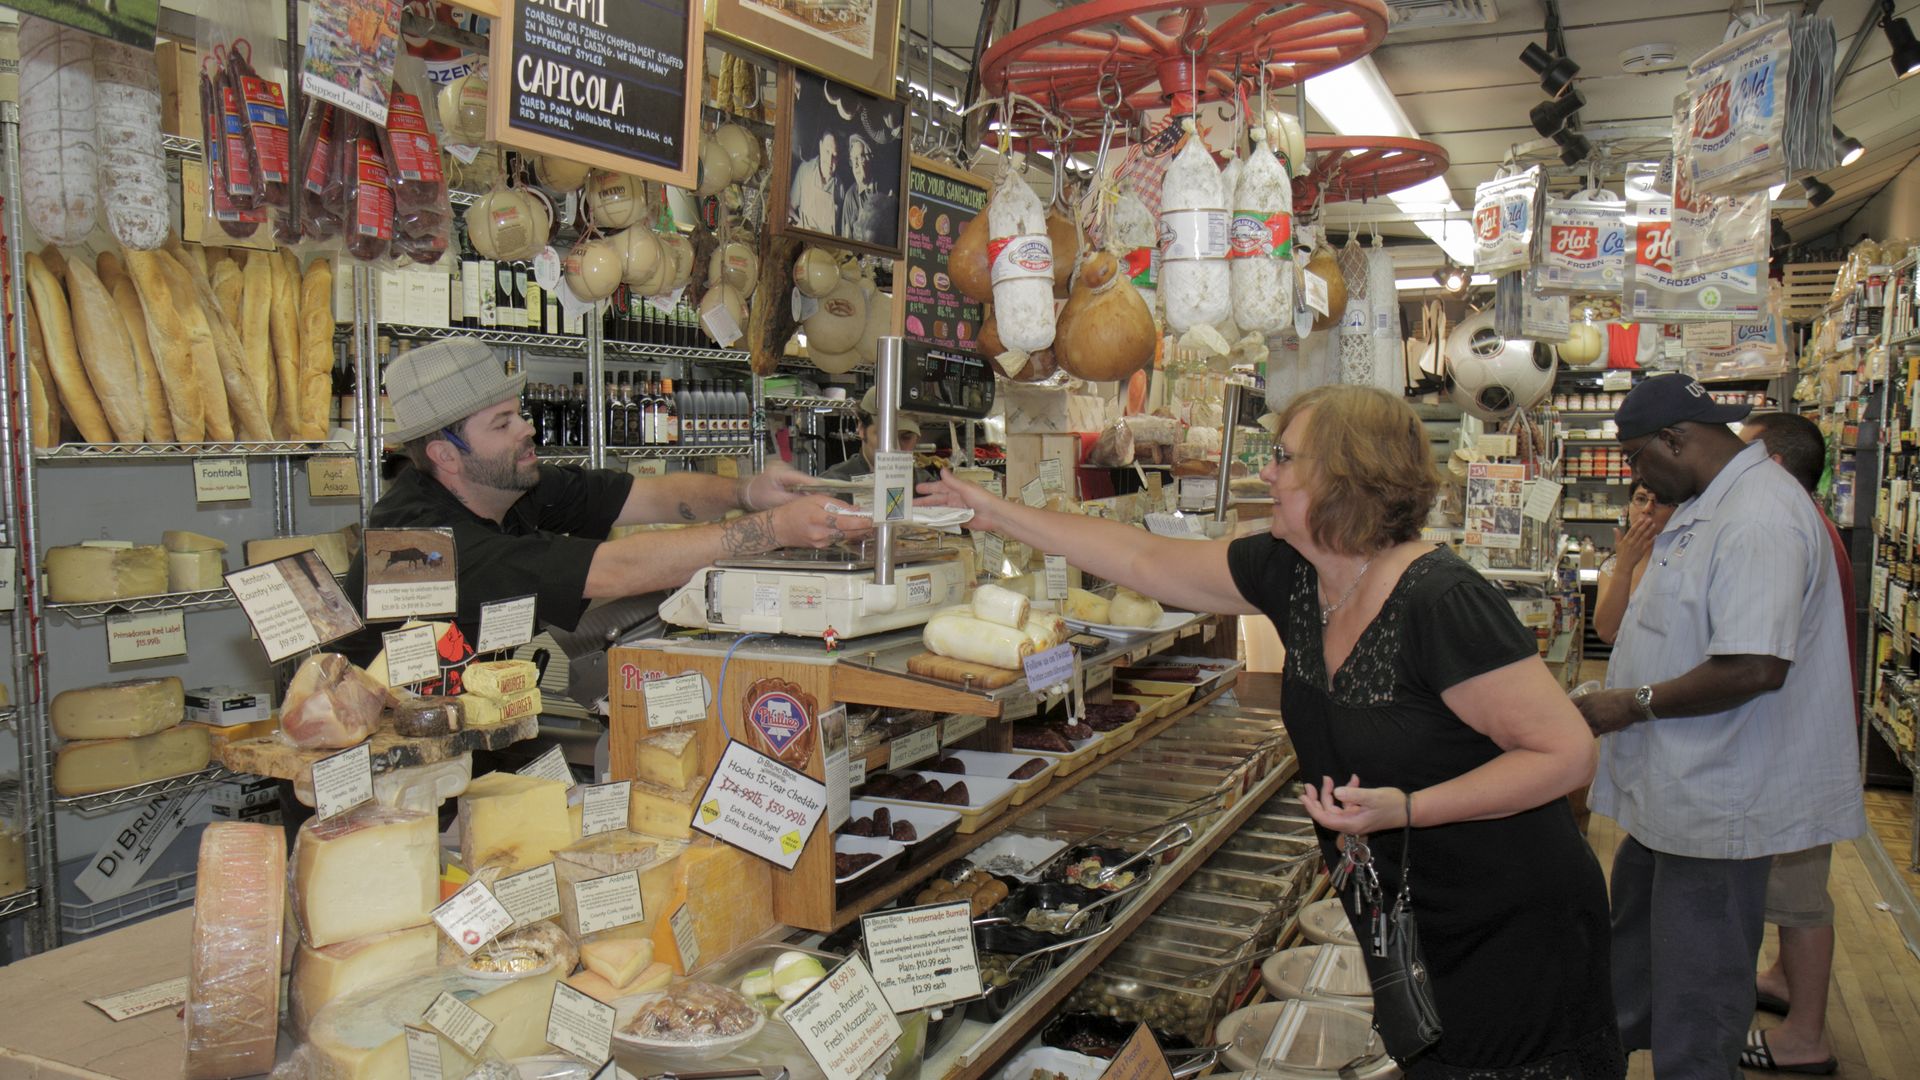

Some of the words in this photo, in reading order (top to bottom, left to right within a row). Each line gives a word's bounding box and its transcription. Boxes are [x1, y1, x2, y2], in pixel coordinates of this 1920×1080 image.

[525, 7, 564, 29] COARSELY
[567, 21, 578, 33] OR
[580, 25, 606, 42] FINELY
[606, 35, 637, 54] CHOPPED
[638, 46, 655, 59] MEAT
[657, 52, 684, 70] STUFFED
[525, 31, 572, 55] DIFFERENT
[525, 20, 536, 31] IN
[538, 23, 544, 34] A
[546, 27, 581, 46] NATURAL
[617, 51, 627, 62] WE
[629, 55, 646, 68] HAVE
[647, 61, 669, 76] MANY
[517, 54, 625, 117] CAPICOLA
[305, 77, 341, 103] Support
[342, 94, 364, 112] Local
[364, 106, 386, 122] Foods
[519, 108, 536, 120] RED
[539, 113, 574, 131] PEPPER.
[520, 95, 546, 110] CURED
[550, 102, 572, 117] PORK
[575, 111, 612, 130] SHOULDER
[615, 123, 635, 136] WITH
[637, 128, 660, 142] BLACK
[663, 136, 674, 146] OR
[1702, 130, 1737, 153] FROZEN
[910, 171, 926, 193] FOR
[928, 176, 946, 198] YOUR
[1478, 208, 1498, 234] Hot
[1557, 229, 1592, 253] Hot
[1567, 259, 1604, 269] FROZEN
[1658, 273, 1707, 288] FROZEN
[1720, 272, 1728, 280] 3
[202, 466, 242, 479] Fontinella
[323, 470, 343, 483] Aged
[323, 483, 349, 494] Asiago
[240, 572, 272, 586] Benton's
[909, 585, 926, 597] 2009
[240, 585, 269, 601] Country
[113, 629, 151, 640] Primadonna
[152, 627, 163, 635] Red
[165, 623, 181, 634] Label
[757, 705, 800, 731] Phillies
[728, 759, 755, 780] Hooks
[756, 773, 785, 795] 15-Year
[787, 788, 819, 811] Cheddar
[724, 814, 740, 829] Extra,
[741, 822, 758, 836] Extra
[758, 830, 775, 845] Sharp
[730, 804, 746, 818] Extra,
[747, 812, 764, 826] Extra
[762, 820, 781, 834] Aged
[97, 850, 124, 877] DI
[116, 793, 168, 850] BRUN
[907, 913, 945, 925] Homemade
[945, 908, 969, 919] Burrata
[870, 941, 880, 949] Our
[880, 938, 902, 947] handmade
[902, 935, 913, 943] fresh
[937, 928, 957, 937] stretched
[957, 926, 966, 934] into
[886, 946, 895, 955] and
[894, 944, 912, 956] wrapped
[912, 941, 928, 950] around
[931, 938, 946, 949] pocket
[945, 937, 952, 945] of
[951, 934, 969, 946] whipped
[913, 951, 922, 959] and
[933, 947, 940, 956] of
[916, 957, 937, 970] $10.99
[937, 954, 952, 966] each
[828, 970, 850, 996] $8.99
[847, 966, 858, 979] lb
[897, 972, 916, 985] Truffle
[912, 983, 933, 997] $12.99
[932, 980, 948, 991] each
[809, 1008, 842, 1039] DiBruno
[838, 984, 871, 1014] Brother's
[823, 1029, 847, 1054] Fresh
[843, 1001, 879, 1037] Mozzarella
[827, 1053, 847, 1072] Hand
[842, 1041, 861, 1059] Made
[857, 1032, 869, 1046] and
[881, 1013, 891, 1024] by
[843, 1060, 858, 1076] Real
[855, 1045, 875, 1064] Human
